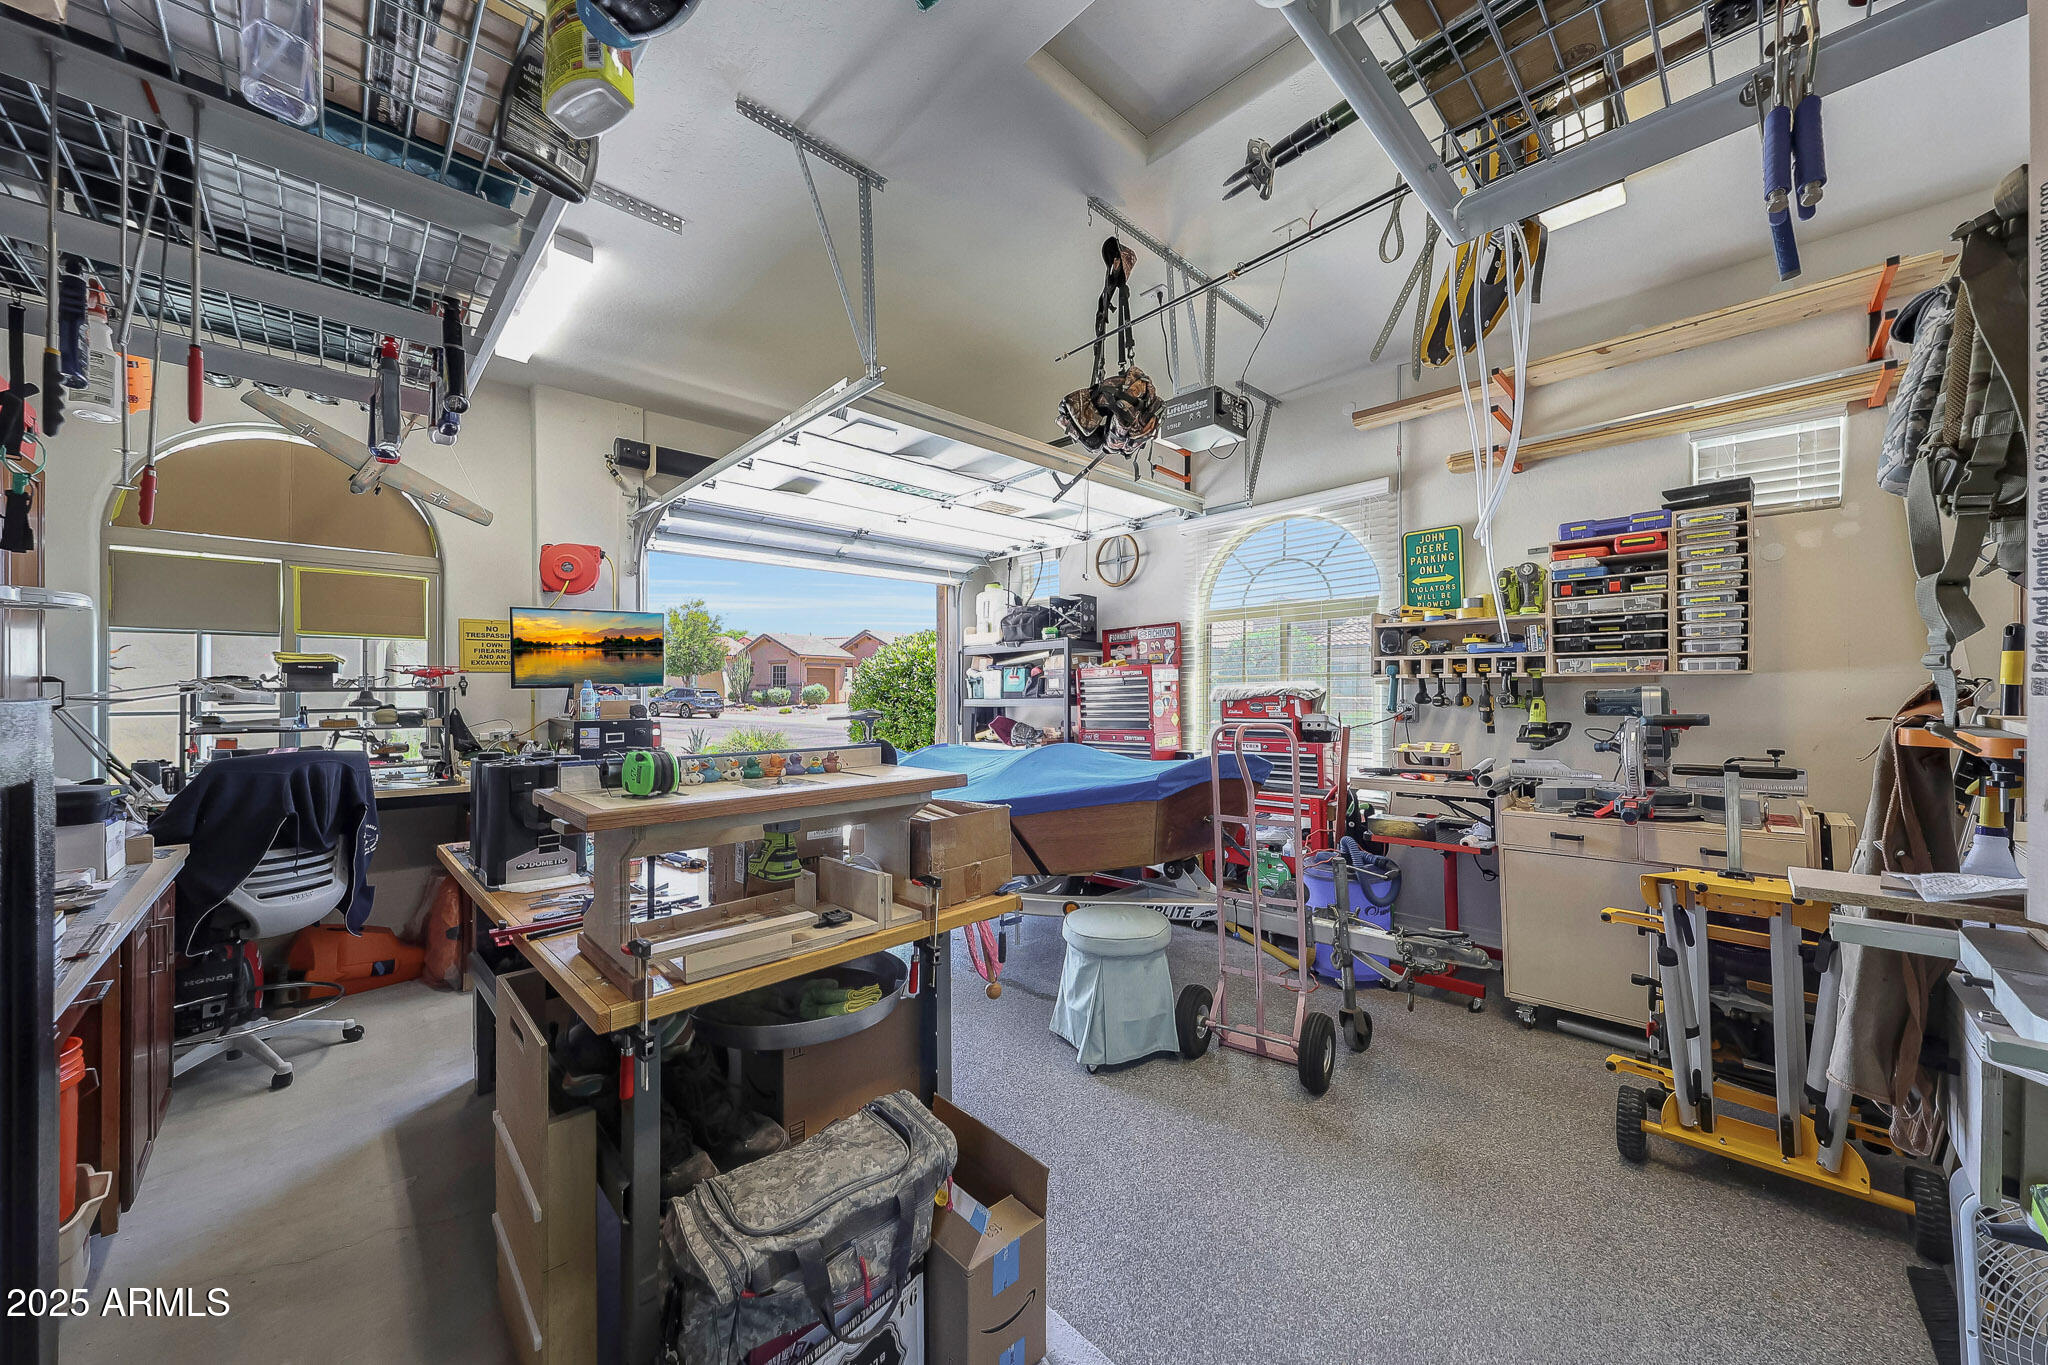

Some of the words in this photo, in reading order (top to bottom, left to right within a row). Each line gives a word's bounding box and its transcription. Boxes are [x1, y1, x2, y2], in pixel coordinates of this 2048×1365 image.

[2033, 487, 2048, 529] Team
[1420, 532, 1445, 544] JOHN
[1416, 542, 1448, 554] DEERE
[1410, 552, 1455, 566] PARKING
[1420, 564, 1445, 575] ONLY
[1411, 583, 1456, 593] VIOLATORS
[1441, 591, 1451, 599] BE
[2032, 597, 2048, 626] And
[2030, 630, 2048, 673] Parke
[529, 858, 566, 868] DOMETIC
[184, 973, 233, 987] HONDA
